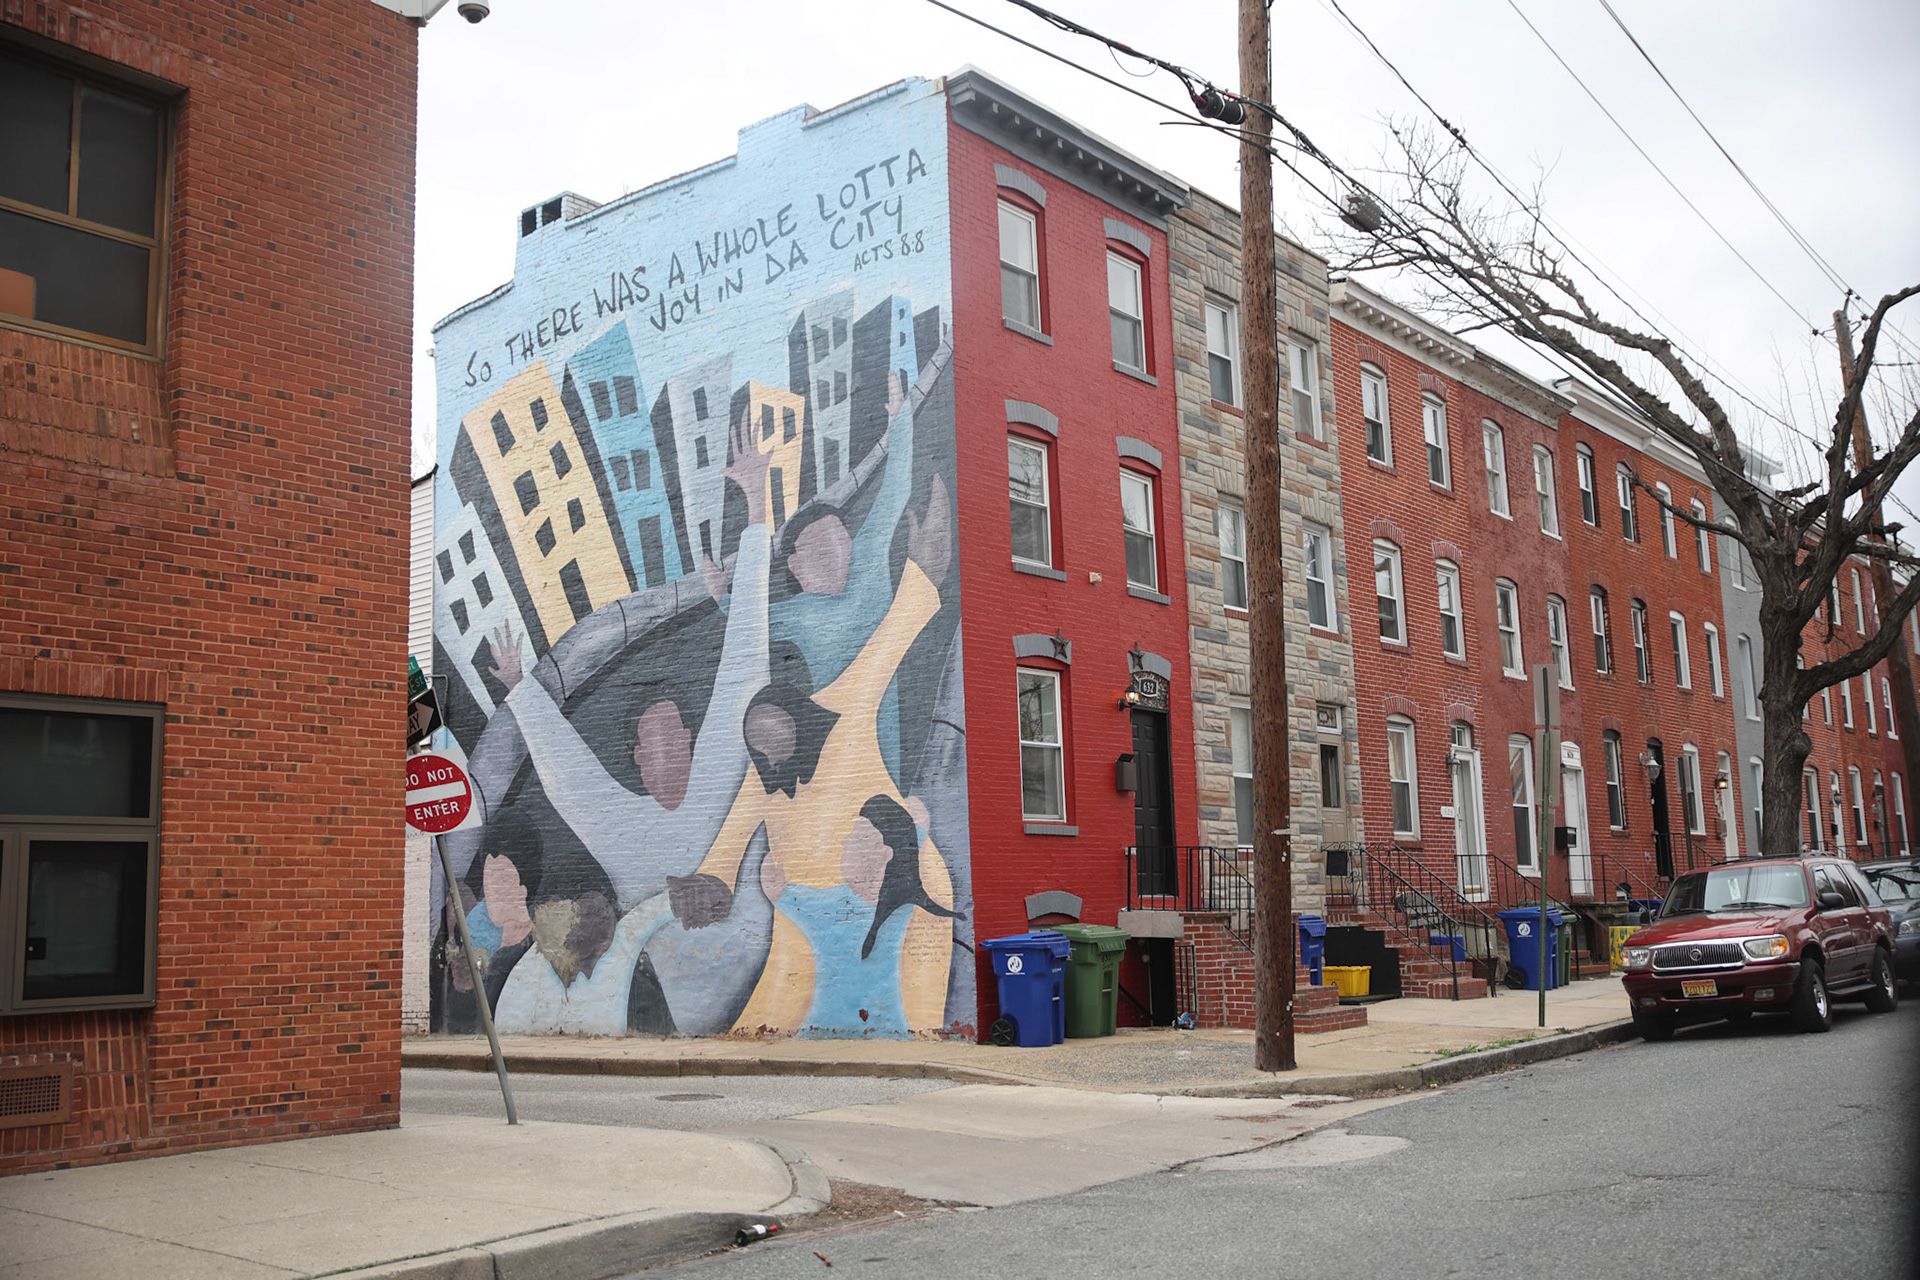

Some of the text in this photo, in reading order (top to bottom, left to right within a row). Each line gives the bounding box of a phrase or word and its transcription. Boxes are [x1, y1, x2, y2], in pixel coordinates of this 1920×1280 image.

[854, 229, 925, 273] ACTS 8:8
[465, 148, 927, 387] SO THERE WAS A WHOLE LOTTA
[650, 283, 701, 332] JOY
[765, 239, 809, 285] DA
[1143, 681, 1154, 693] 632
[427, 766, 454, 783] NOT
[413, 801, 460, 820] ENTER
